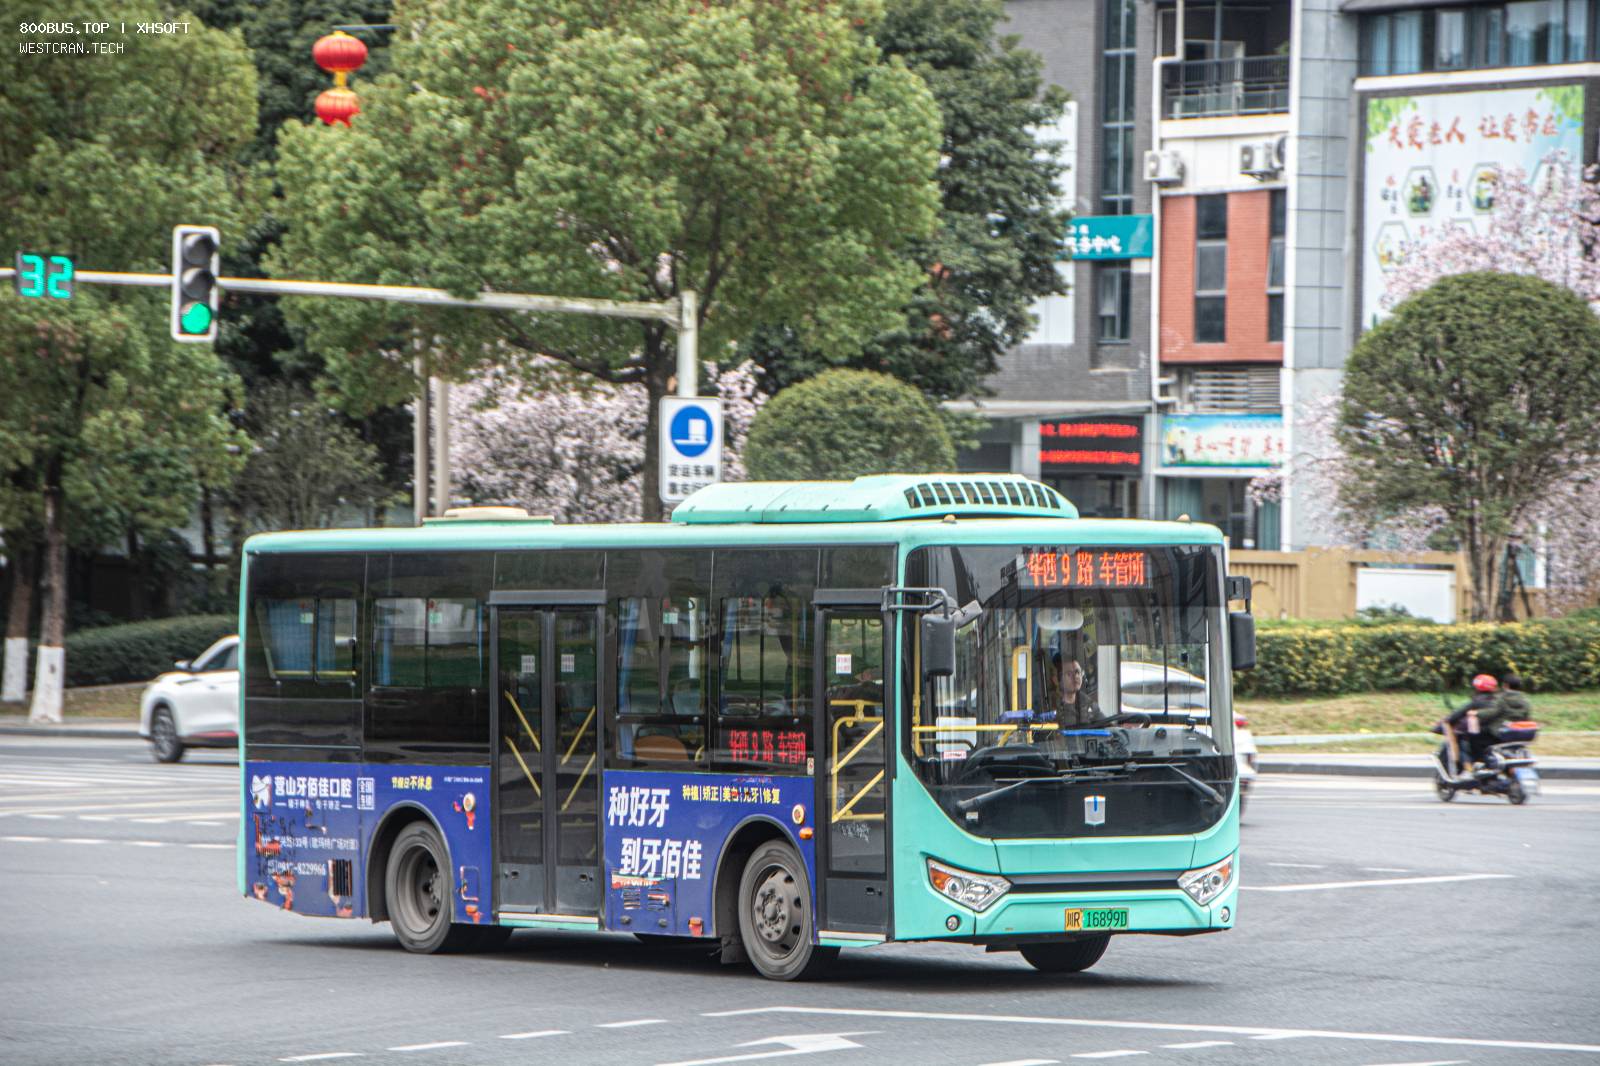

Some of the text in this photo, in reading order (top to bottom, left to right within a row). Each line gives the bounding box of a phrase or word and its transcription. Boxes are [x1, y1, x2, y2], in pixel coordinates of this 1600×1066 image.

[21, 254, 74, 299] 32
[1028, 552, 1144, 586] 华西 9 路 车管所
[762, 730, 774, 763] 路
[274, 776, 352, 798] 营山牙佰佳口腔
[608, 786, 671, 828] 种好牙
[620, 837, 702, 880] 到牙佰佳
[1066, 911, 1128, 928] 川R 16899D
